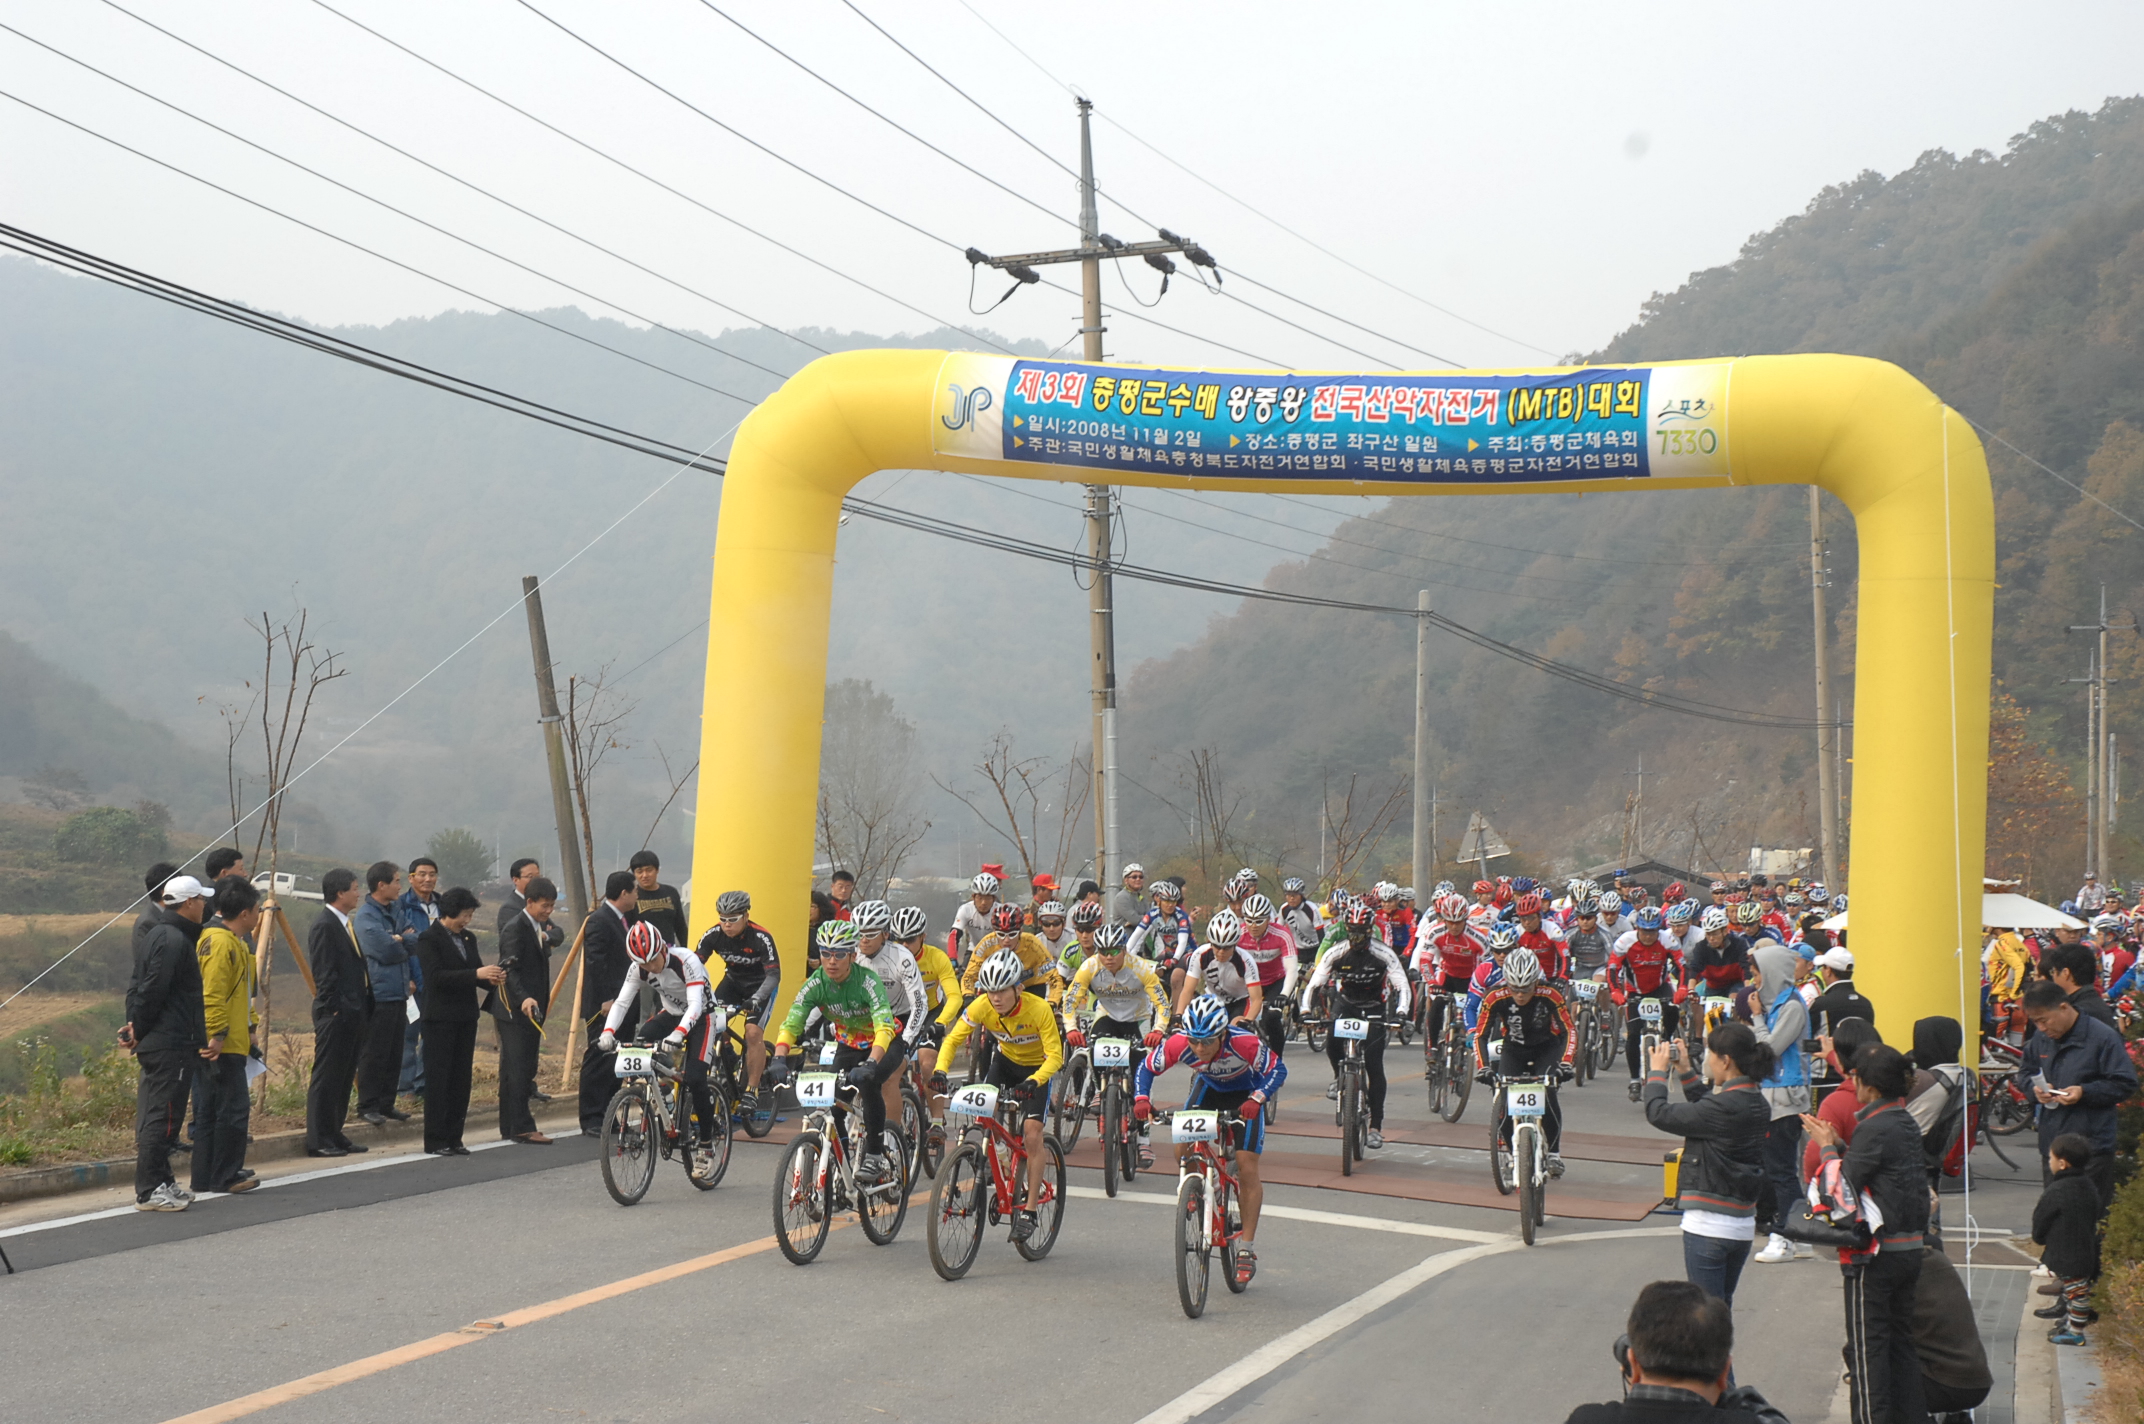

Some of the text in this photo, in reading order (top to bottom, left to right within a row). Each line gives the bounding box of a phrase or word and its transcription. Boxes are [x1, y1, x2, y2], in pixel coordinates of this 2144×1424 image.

[1014, 369, 1642, 426] 제3회 증평군수배 왕중왕 전국산악자전거 (MTB)대회
[1028, 415, 1201, 447] 일시:2008년 11월 2일
[1245, 433, 1438, 453] 장소:증평군 좌구산 일원
[1488, 430, 1638, 453] 주최:증평군체육회
[1656, 428, 1718, 456] 7330
[1577, 983, 1597, 994] 186
[1641, 1004, 1660, 1014] 104
[1343, 1019, 1361, 1031] 50
[1102, 1045, 1121, 1058] 33
[623, 1057, 642, 1071] 38
[803, 1082, 824, 1097] 41
[962, 1091, 987, 1107] 46
[1516, 1093, 1537, 1107] 48
[1182, 1118, 1207, 1133] 42
